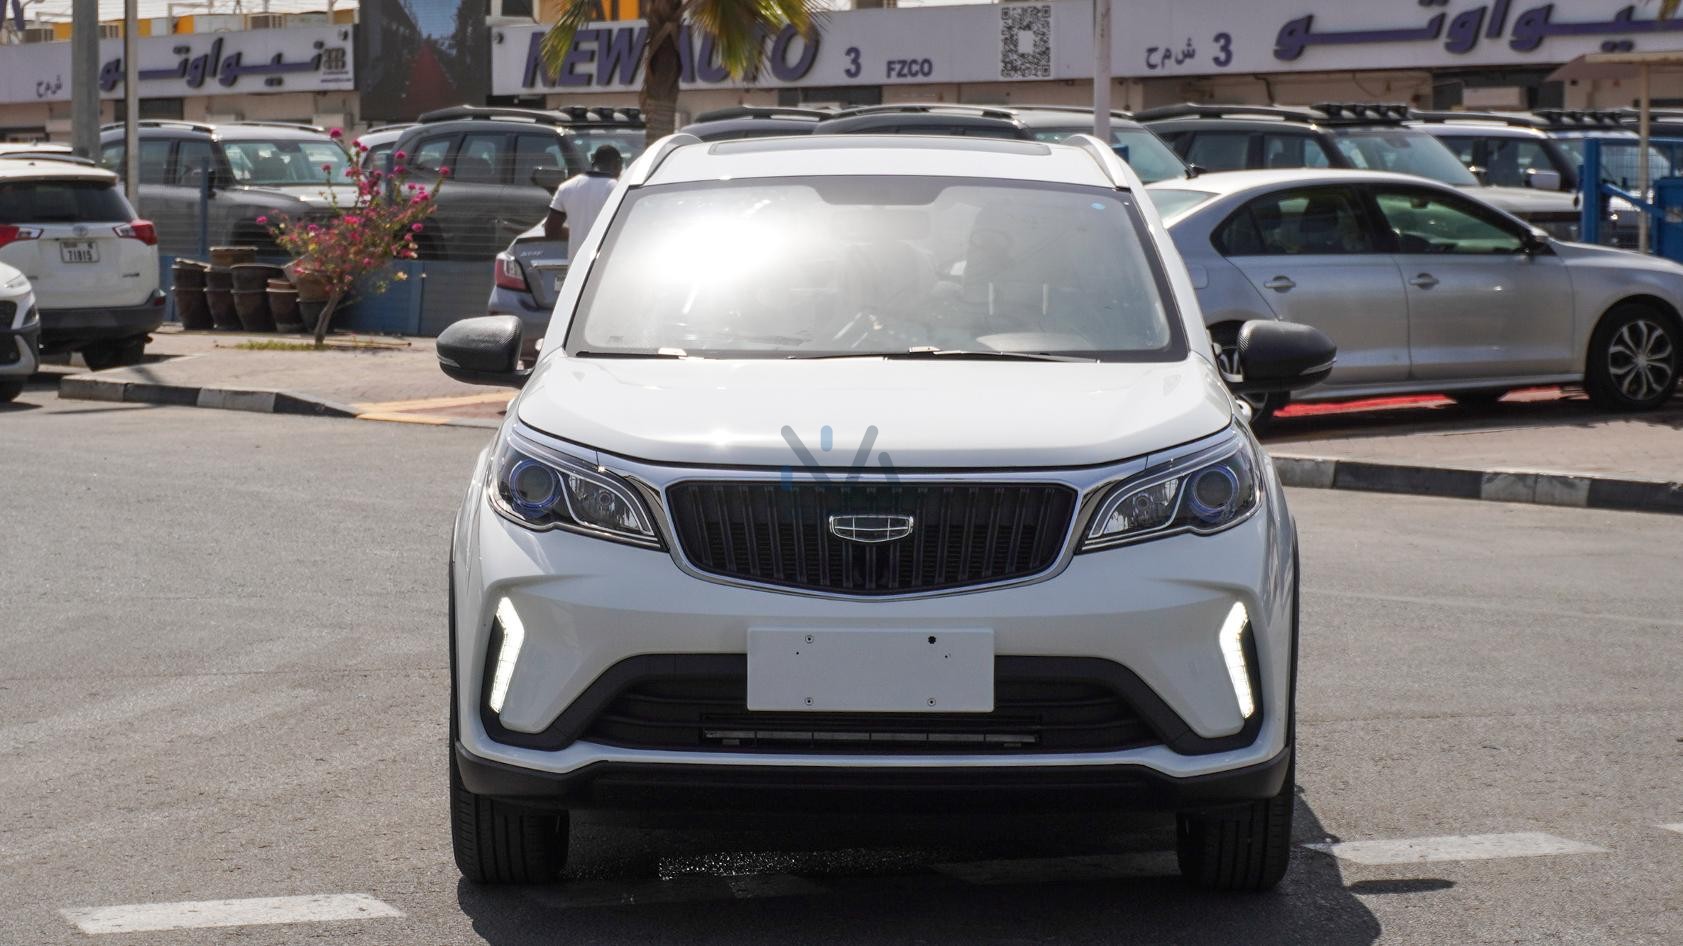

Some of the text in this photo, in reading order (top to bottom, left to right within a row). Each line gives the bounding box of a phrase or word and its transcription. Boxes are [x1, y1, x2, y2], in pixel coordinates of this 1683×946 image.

[521, 27, 649, 88] NEW
[844, 46, 862, 79] 3
[886, 58, 933, 79] FZCO
[1212, 32, 1233, 67] 3
